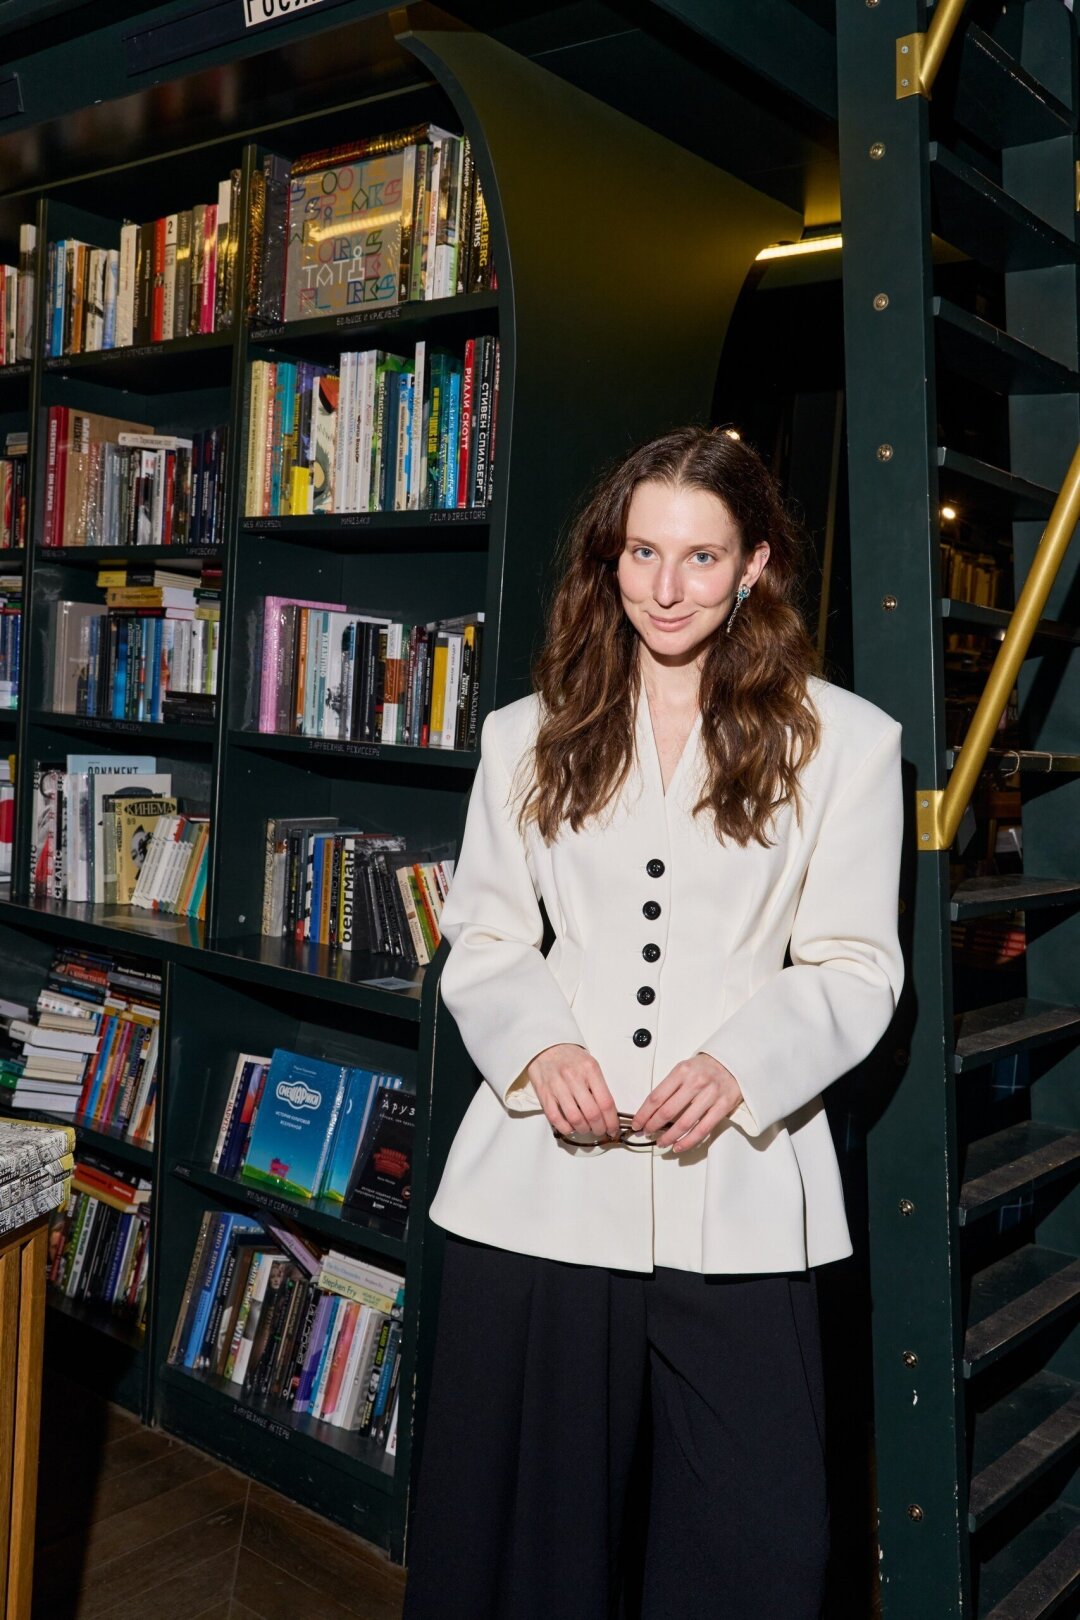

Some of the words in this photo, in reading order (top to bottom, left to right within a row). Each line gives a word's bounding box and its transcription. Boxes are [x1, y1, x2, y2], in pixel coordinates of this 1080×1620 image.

[167, 220, 173, 234] 2
[473, 216, 481, 248] FILMS
[463, 367, 472, 408] РИДЛИ
[479, 382, 489, 428] СТИВЕН
[49, 420, 58, 466] EISENSTEIN
[461, 412, 470, 450] СКОТТ
[264, 453, 272, 493] DISPATCH
[475, 432, 486, 493] СПИЛБЕРГ
[48, 473, 55, 485] ON
[47, 486, 55, 511] PAPER
[430, 512, 445, 521] FILM
[447, 511, 486, 520] DIRECTORS
[320, 632, 329, 677] TARANTINO
[469, 682, 479, 735] ПАЗОЛИНИ
[127, 802, 174, 815] КИНЕМА
[55, 850, 63, 899] СЕАНС
[342, 849, 355, 943] бергман
[278, 1083, 320, 1105] СМЕШАРИКИ
[221, 1101, 234, 1133] НАРУТО
[214, 1223, 226, 1250] КИНО
[322, 1275, 346, 1294] Stephen
[346, 1284, 357, 1298] Fry
[231, 1320, 245, 1352] WILL
